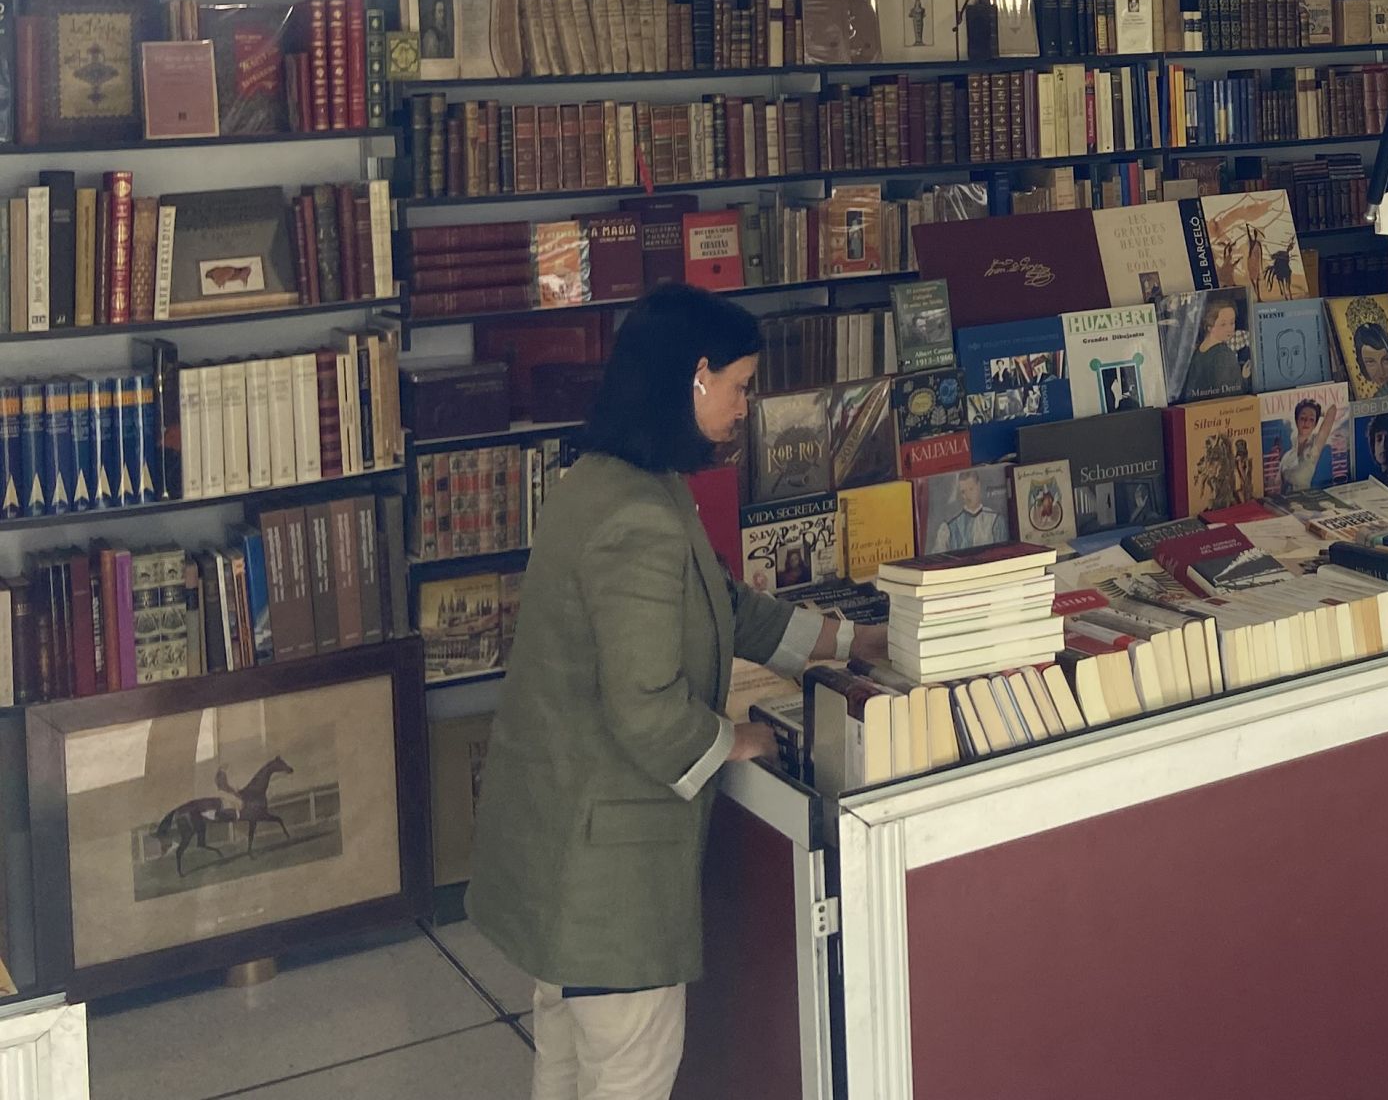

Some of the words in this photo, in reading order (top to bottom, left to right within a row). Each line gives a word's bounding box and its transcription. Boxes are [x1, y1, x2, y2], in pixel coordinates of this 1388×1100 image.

[1189, 216, 1210, 270] BARCELÓ
[1068, 309, 1156, 333] HUMBERT
[1190, 387, 1220, 398] Maurice
[1353, 401, 1379, 415] BOB
[1193, 418, 1222, 431] Silvia
[1227, 425, 1256, 438] Bruno
[911, 436, 970, 463] KALEVALA
[1079, 457, 1159, 484] Schommer
[747, 510, 775, 525] VIDA
[776, 502, 820, 519] SECRETA
[850, 543, 909, 566] rivalidad
